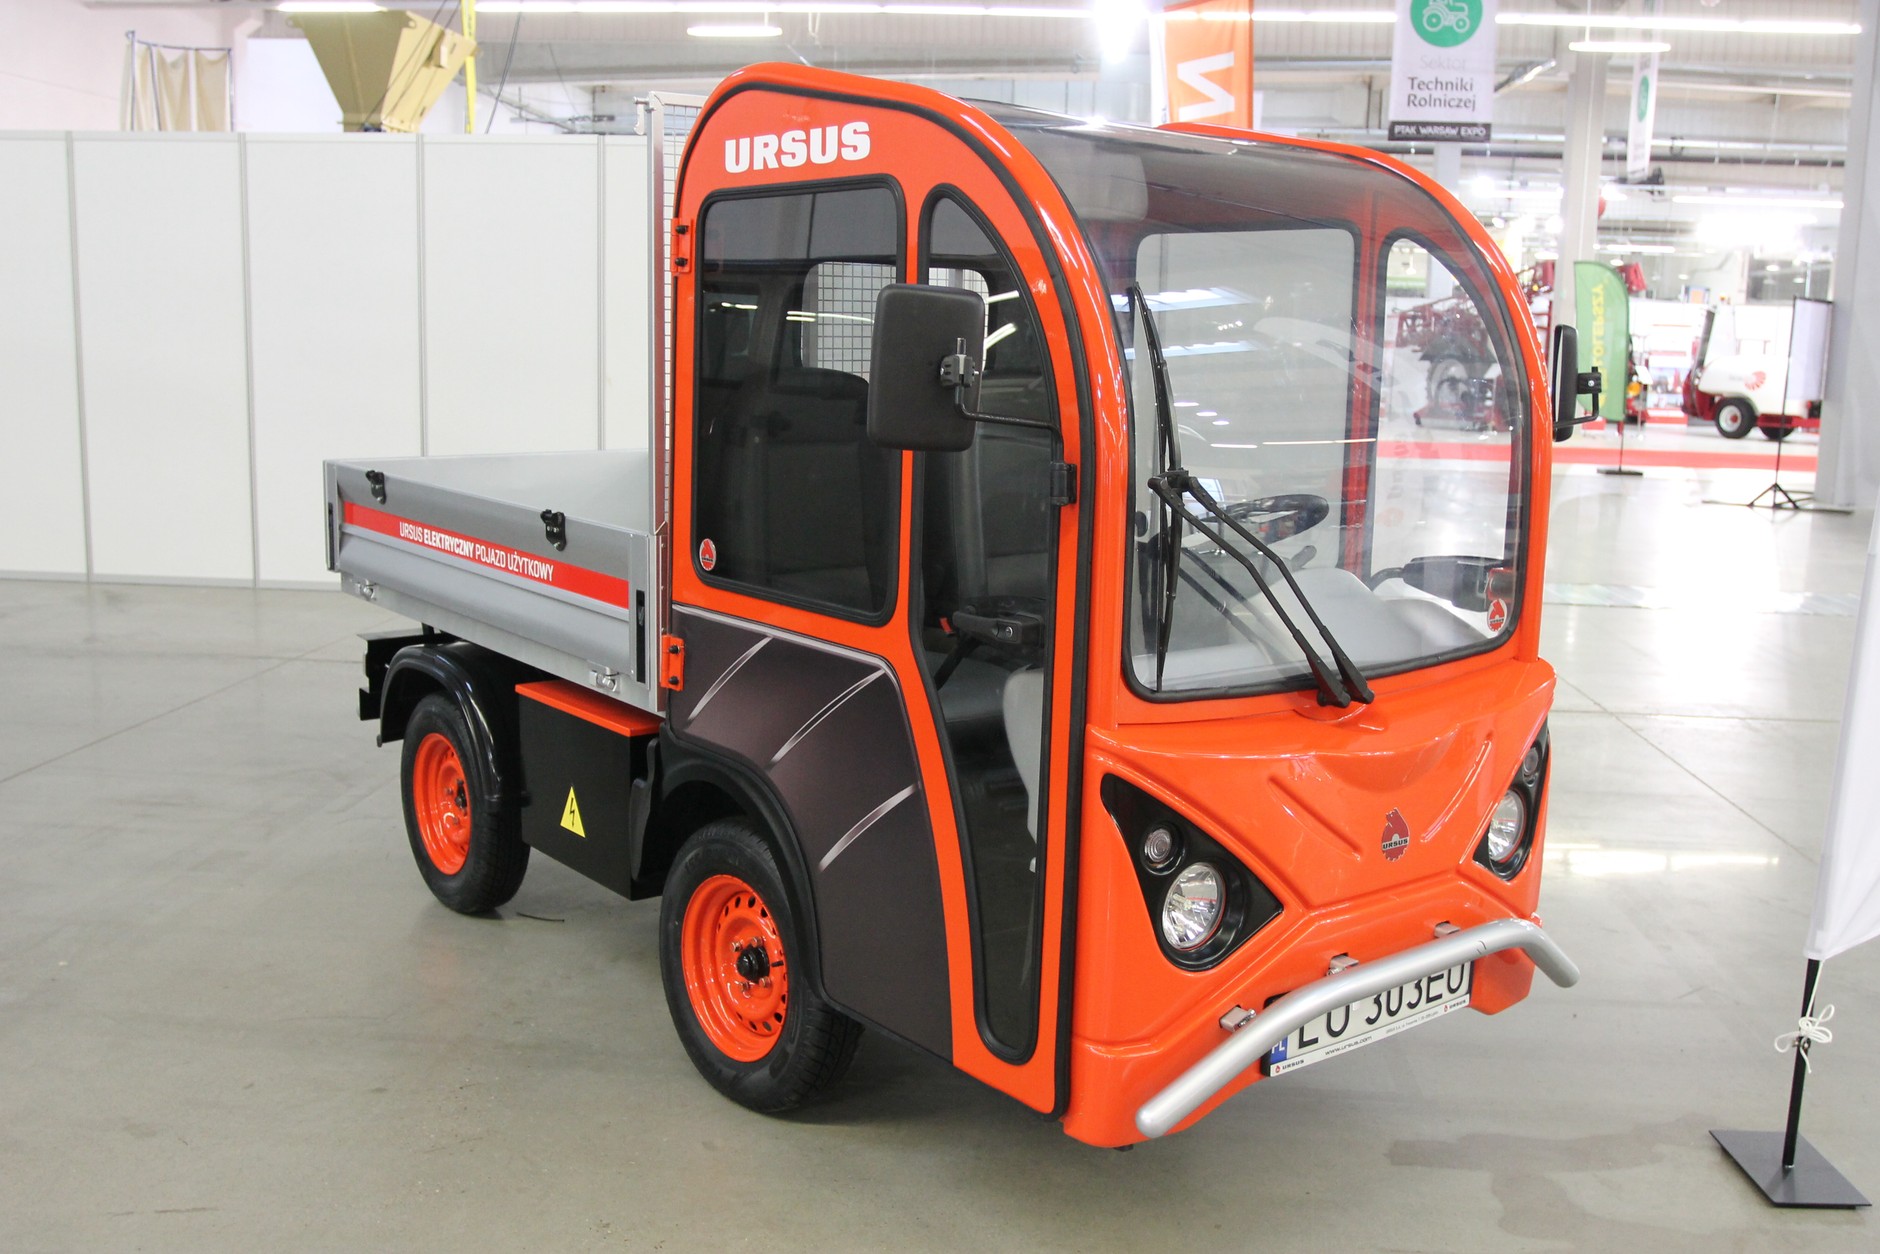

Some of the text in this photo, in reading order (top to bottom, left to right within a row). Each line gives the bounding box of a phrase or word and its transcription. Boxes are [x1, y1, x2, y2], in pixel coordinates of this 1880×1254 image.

[1407, 76, 1474, 92] Techniki
[1406, 93, 1477, 112] Rolniczej
[1461, 127, 1487, 138] EXPO
[724, 121, 871, 174] URSUS
[399, 521, 554, 582] URSUS ELEKTRYCZNY POJAZD UŻYTKOWY
[1382, 838, 1408, 850] URSUS
